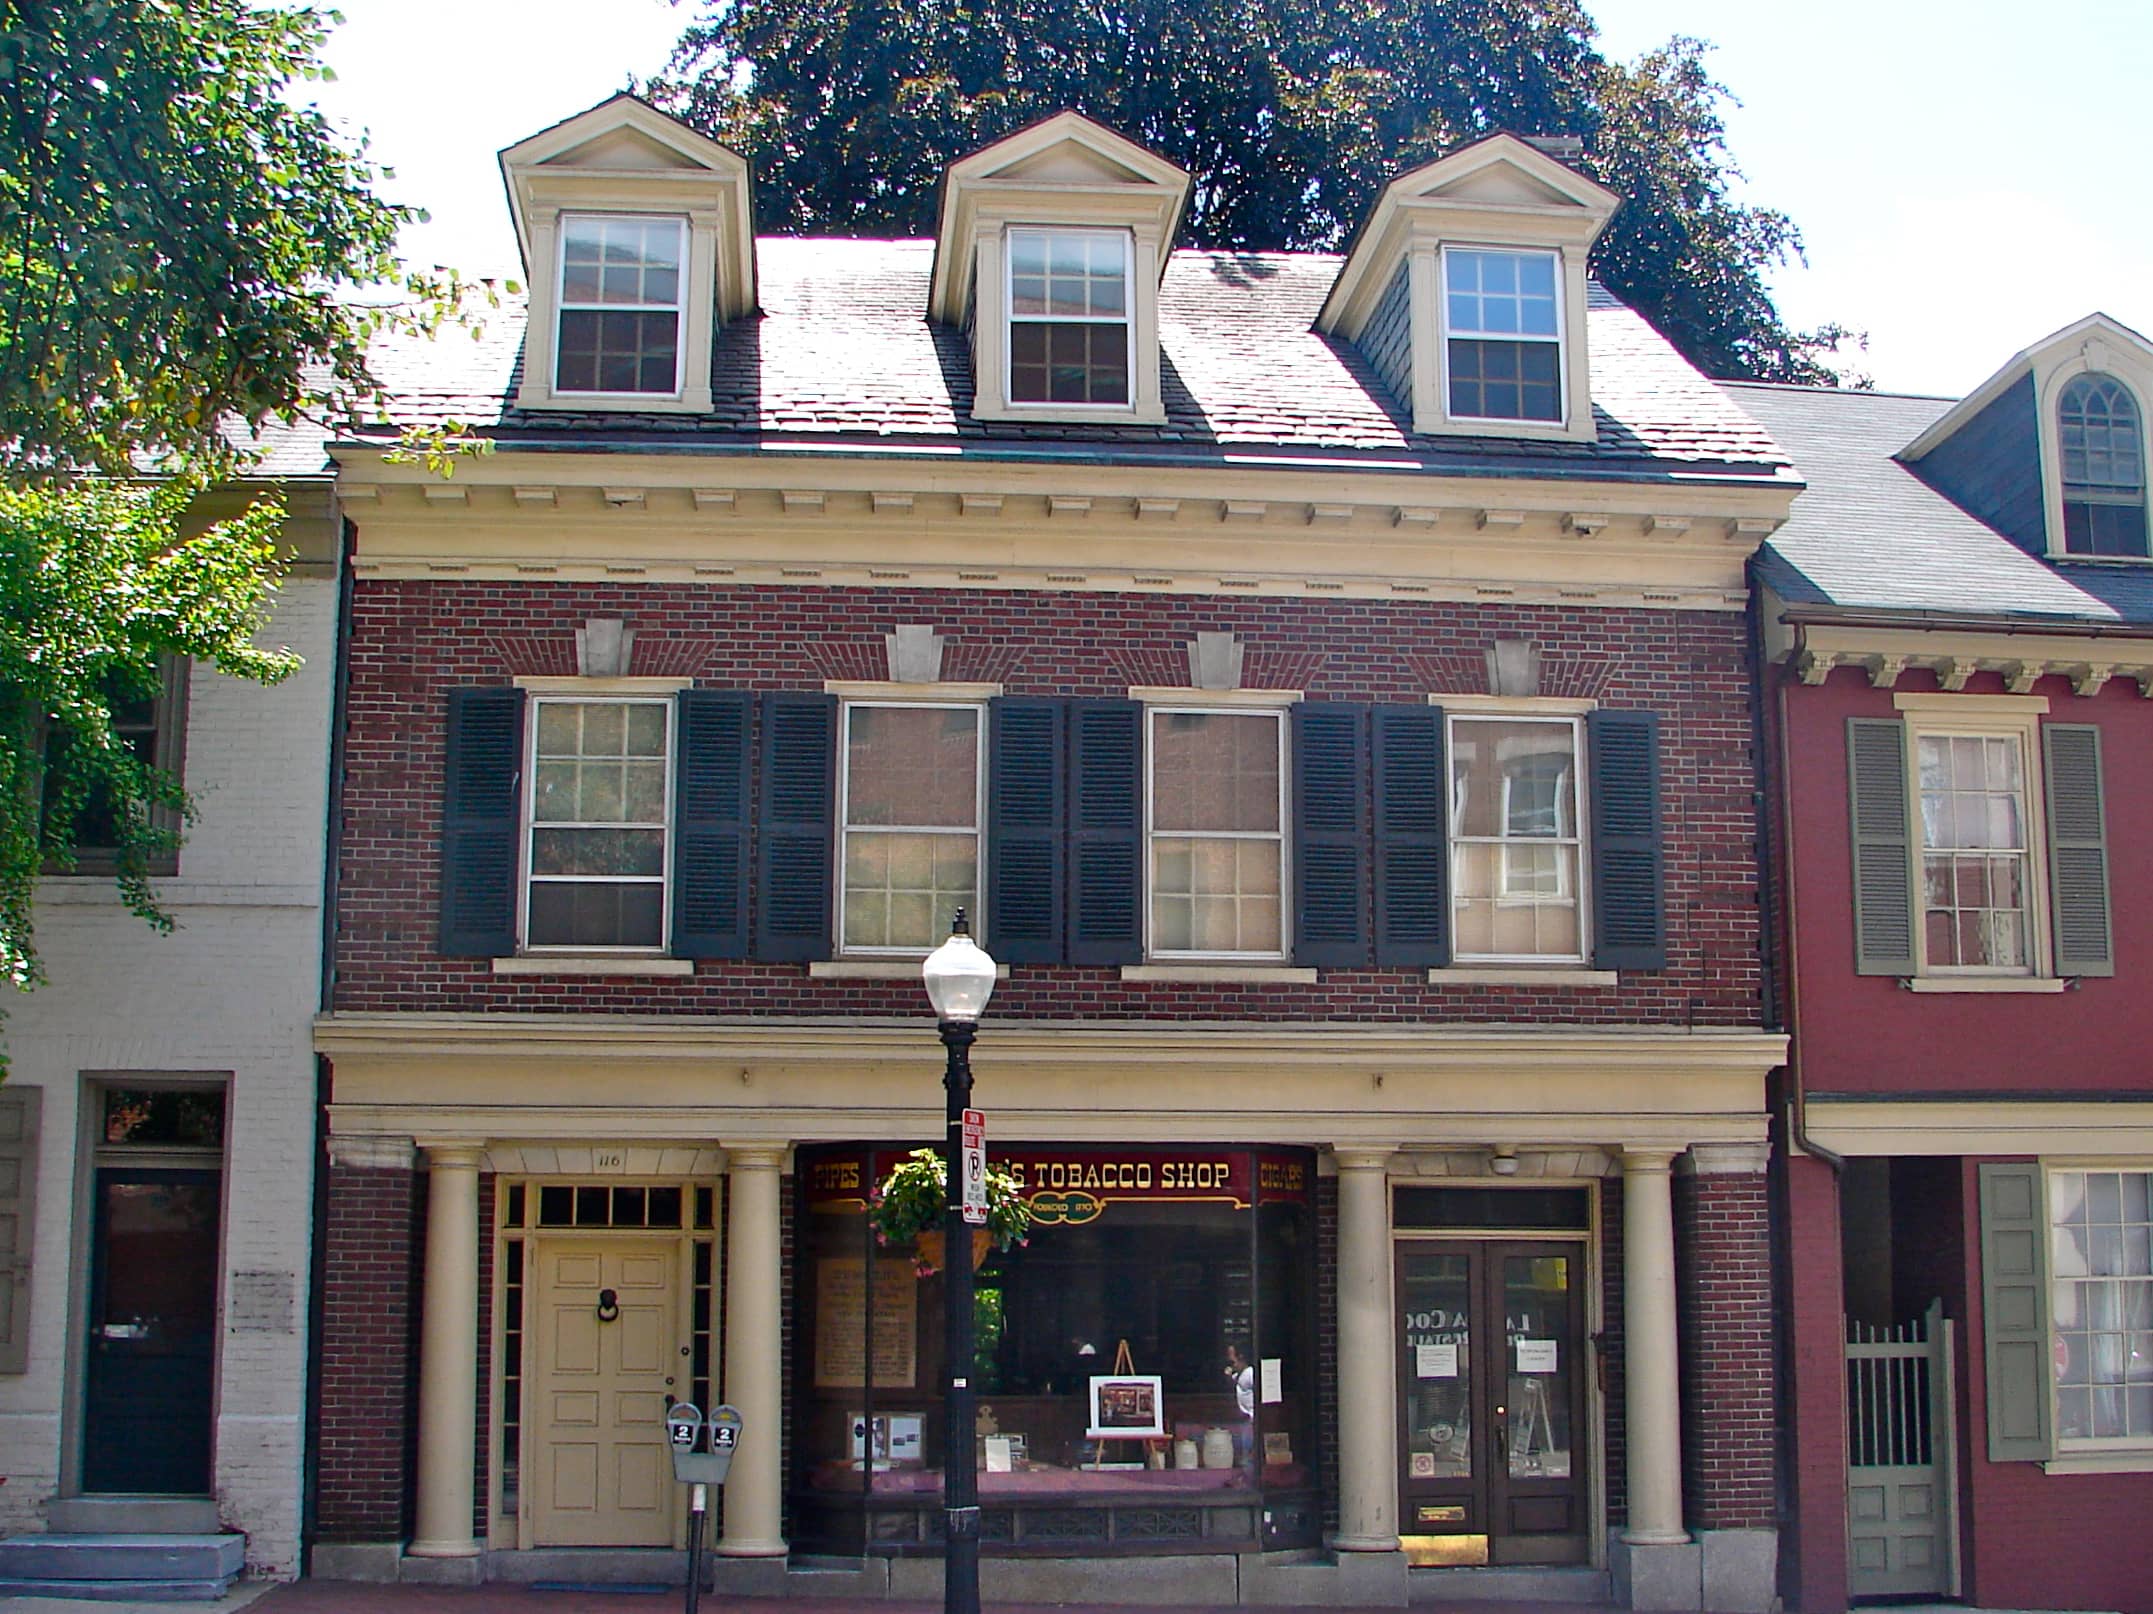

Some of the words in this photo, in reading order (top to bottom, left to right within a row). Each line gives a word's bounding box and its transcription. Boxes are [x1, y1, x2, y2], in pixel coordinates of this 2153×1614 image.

[599, 1154, 620, 1168] 116
[815, 1162, 860, 1190] PIPES
[1034, 1163, 1150, 1189] TOBACCO
[1161, 1163, 1229, 1189] SHOP
[1260, 1162, 1303, 1190] CIGARS
[678, 1425, 689, 1437] 2
[720, 1428, 730, 1440] 2
